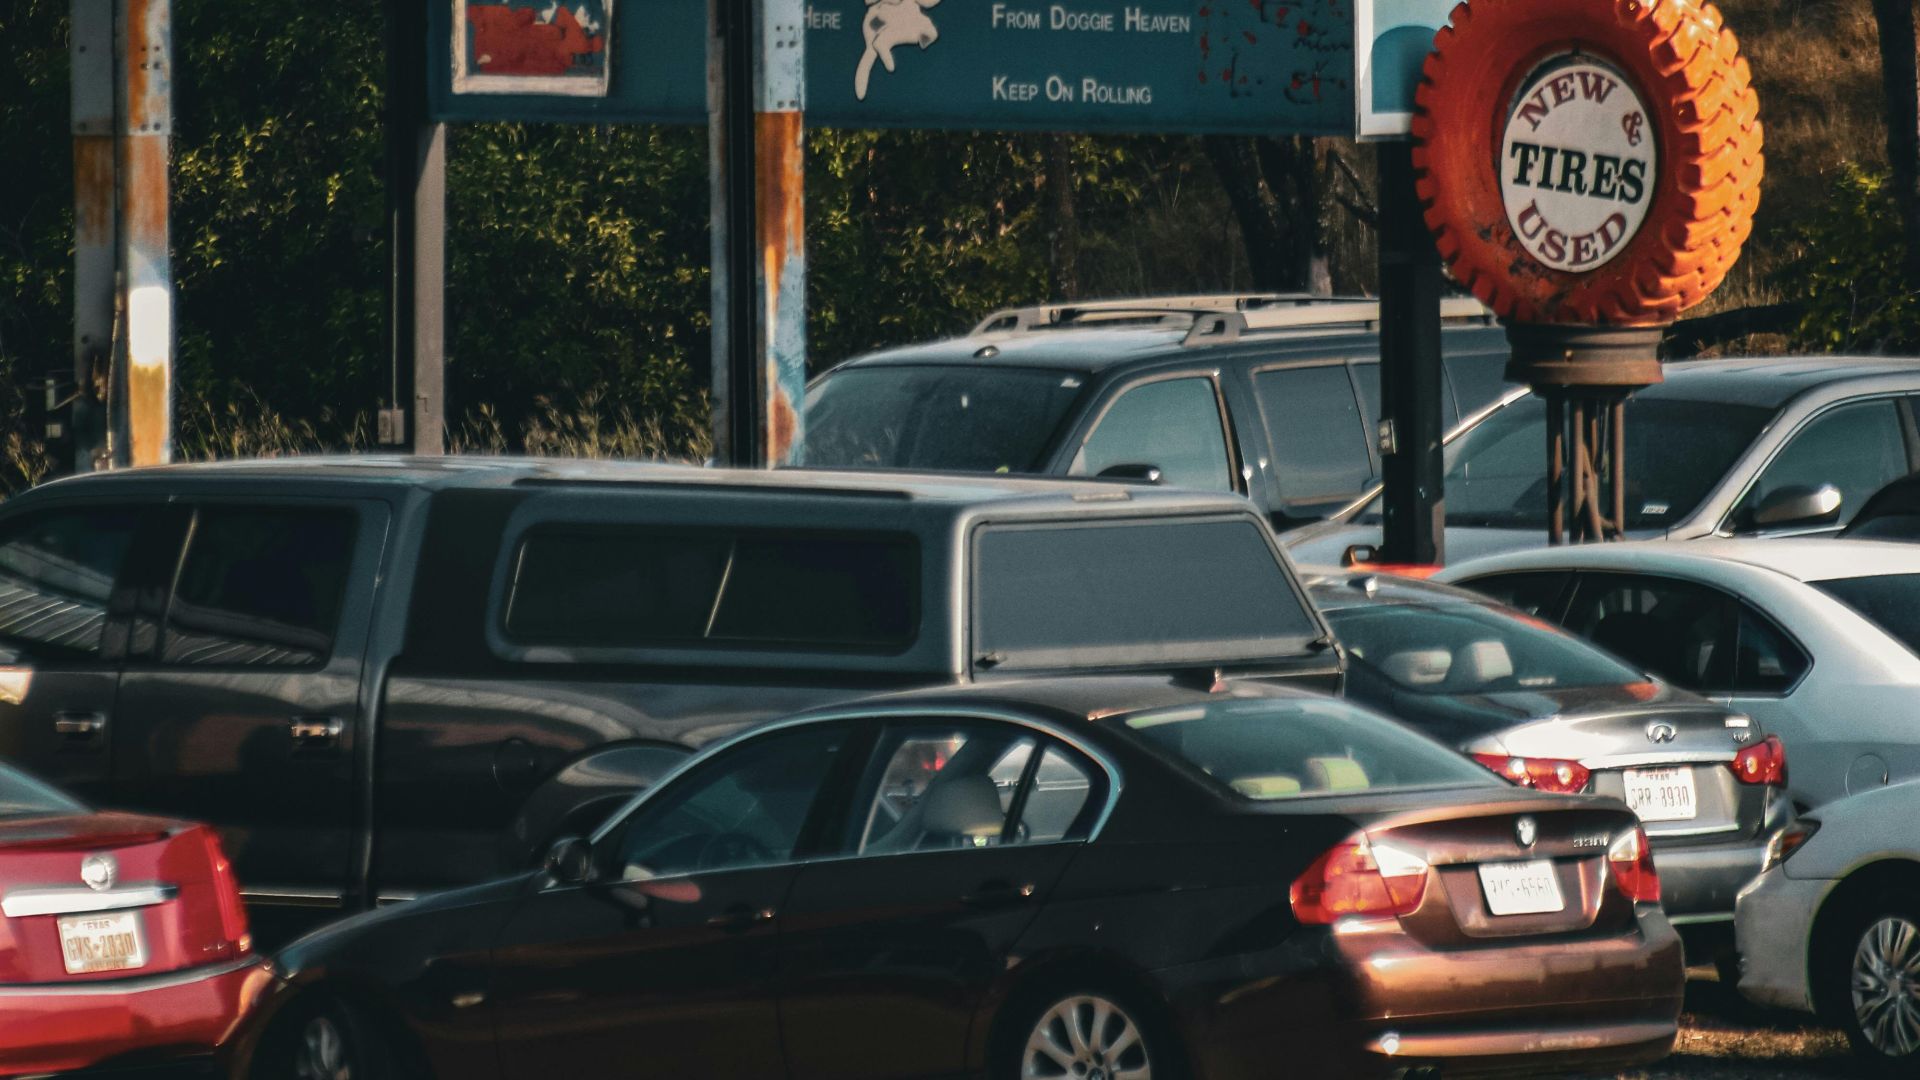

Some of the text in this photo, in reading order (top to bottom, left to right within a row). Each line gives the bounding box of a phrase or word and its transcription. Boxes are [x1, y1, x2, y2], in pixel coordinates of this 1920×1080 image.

[992, 4, 1190, 33] FROM DOGGIE HEAVEN
[992, 75, 1152, 104] KEEP ON ROLLING
[1517, 72, 1643, 147] NEW &
[1510, 141, 1647, 205] TIRES
[1517, 199, 1627, 266] USED
